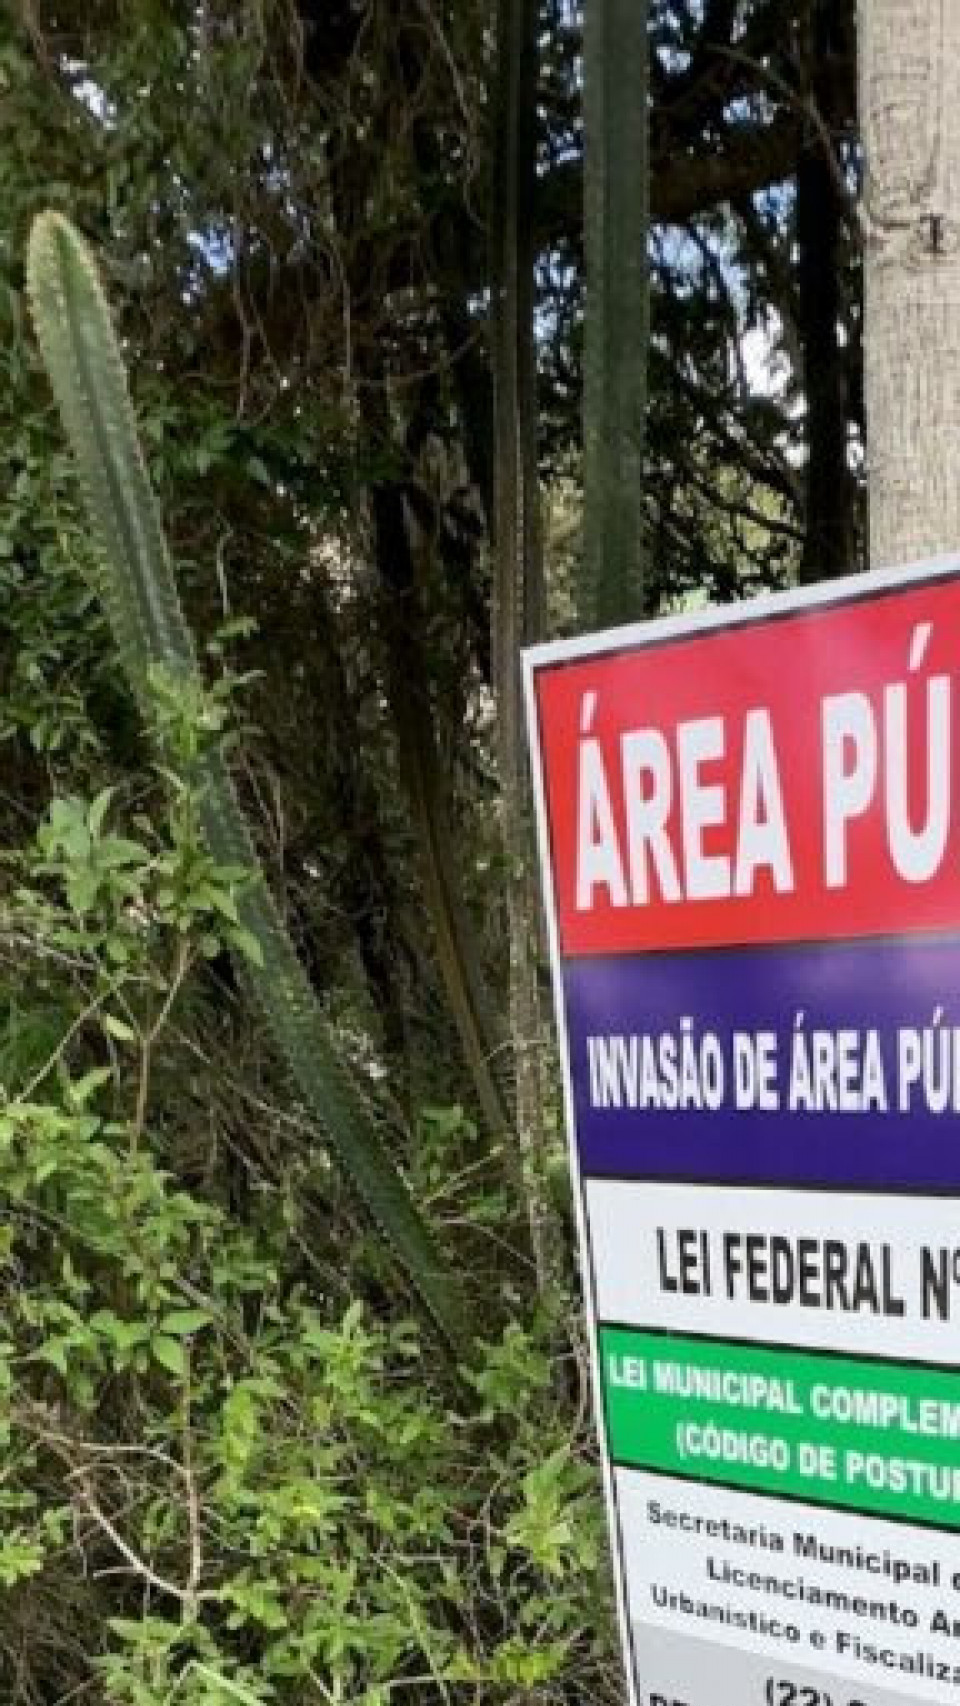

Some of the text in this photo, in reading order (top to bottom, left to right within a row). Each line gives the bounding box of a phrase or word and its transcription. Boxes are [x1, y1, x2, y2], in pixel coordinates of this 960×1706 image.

[576, 691, 795, 911] ÁREA
[587, 1016, 723, 1110] INVASÃO
[733, 1034, 780, 1112] DE
[788, 1010, 888, 1113] ÁREA
[657, 1227, 712, 1296] LEI
[723, 1235, 905, 1318] FEDERAL
[608, 1352, 646, 1387] LEI
[654, 1361, 801, 1415] MUNICIPAL
[676, 1418, 789, 1473] (CÓDIGO
[801, 1446, 837, 1482] DE
[646, 1500, 785, 1553] Secretaria
[793, 1532, 942, 1590] Municipal
[707, 1556, 920, 1629] Licenciamento
[809, 1627, 827, 1650] e
